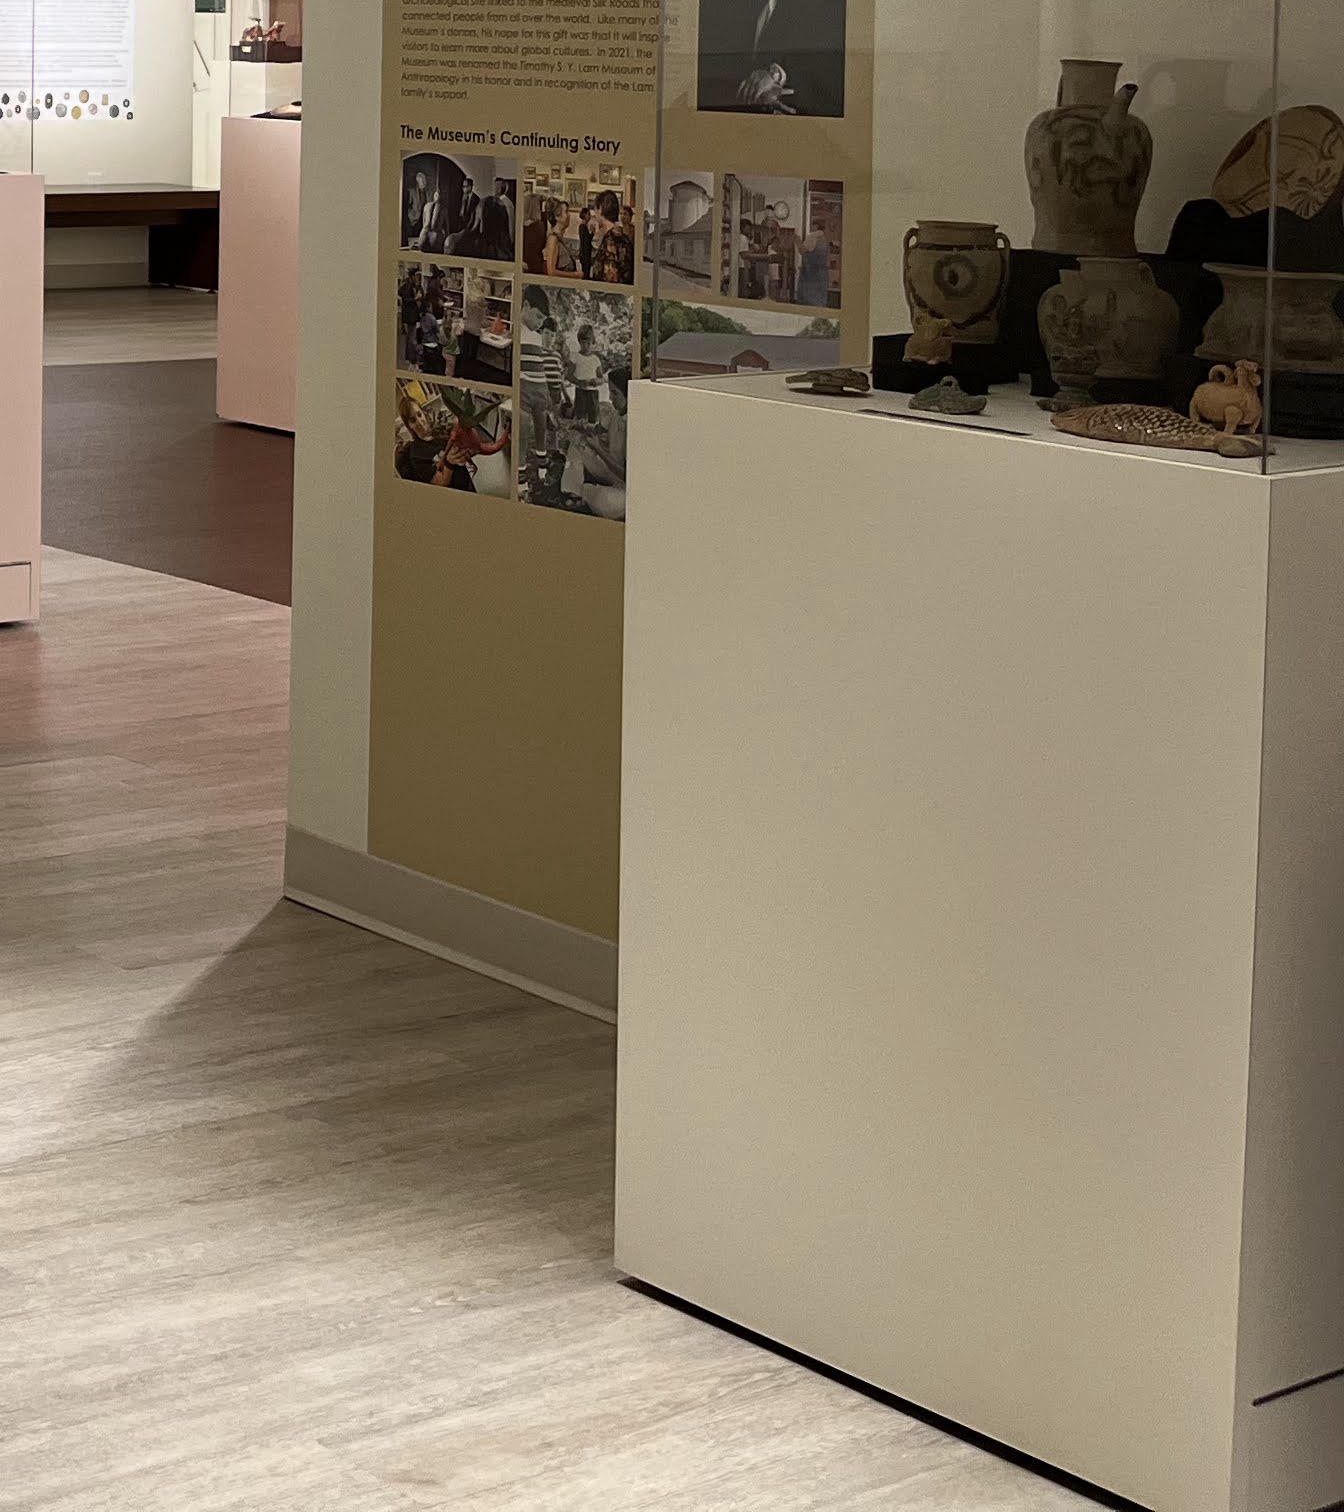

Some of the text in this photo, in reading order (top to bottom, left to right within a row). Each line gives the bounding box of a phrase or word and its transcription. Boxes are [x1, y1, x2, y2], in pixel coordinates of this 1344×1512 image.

[400, 125, 621, 156] The Museum's Continuing Story
